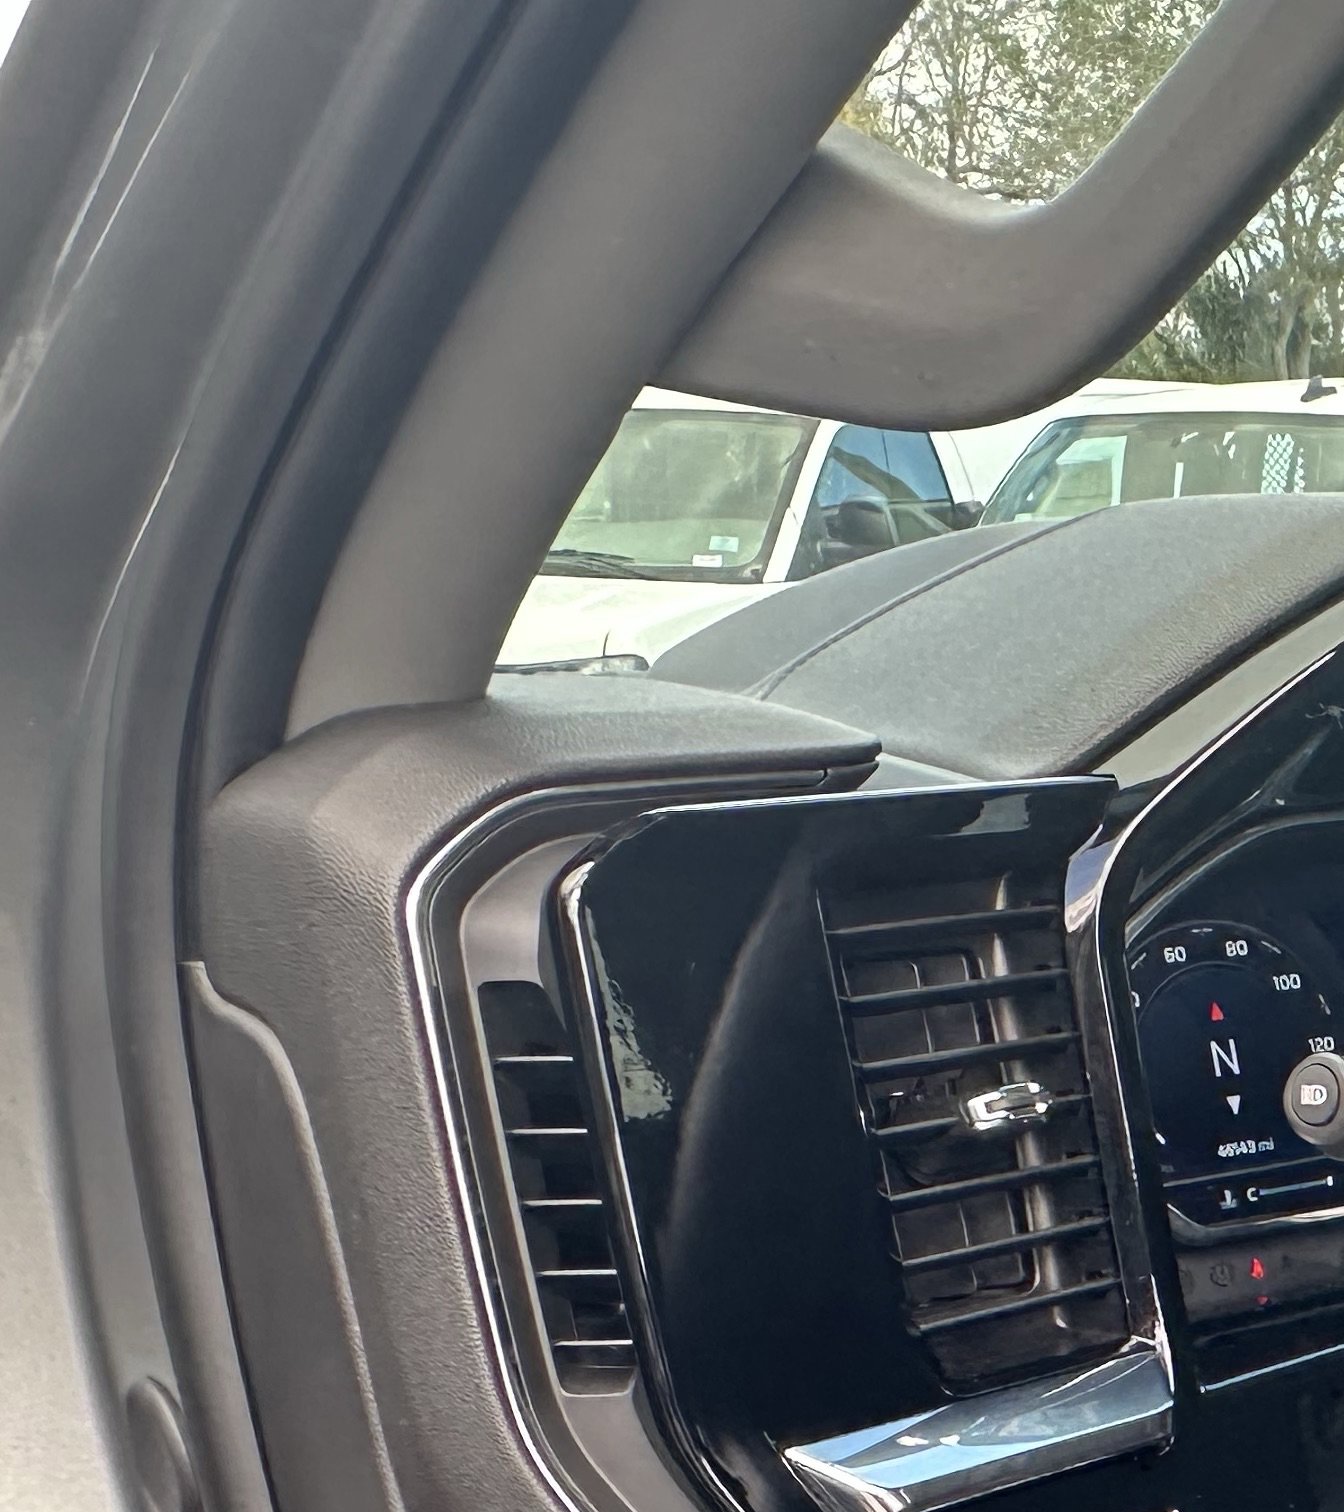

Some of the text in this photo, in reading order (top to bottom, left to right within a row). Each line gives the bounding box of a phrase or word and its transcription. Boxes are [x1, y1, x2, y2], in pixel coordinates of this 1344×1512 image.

[1163, 946, 1187, 963] 60
[1225, 939, 1249, 957] 80
[1272, 973, 1301, 991] 100
[1308, 1036, 1335, 1053] 120
[1209, 1038, 1241, 1078] N
